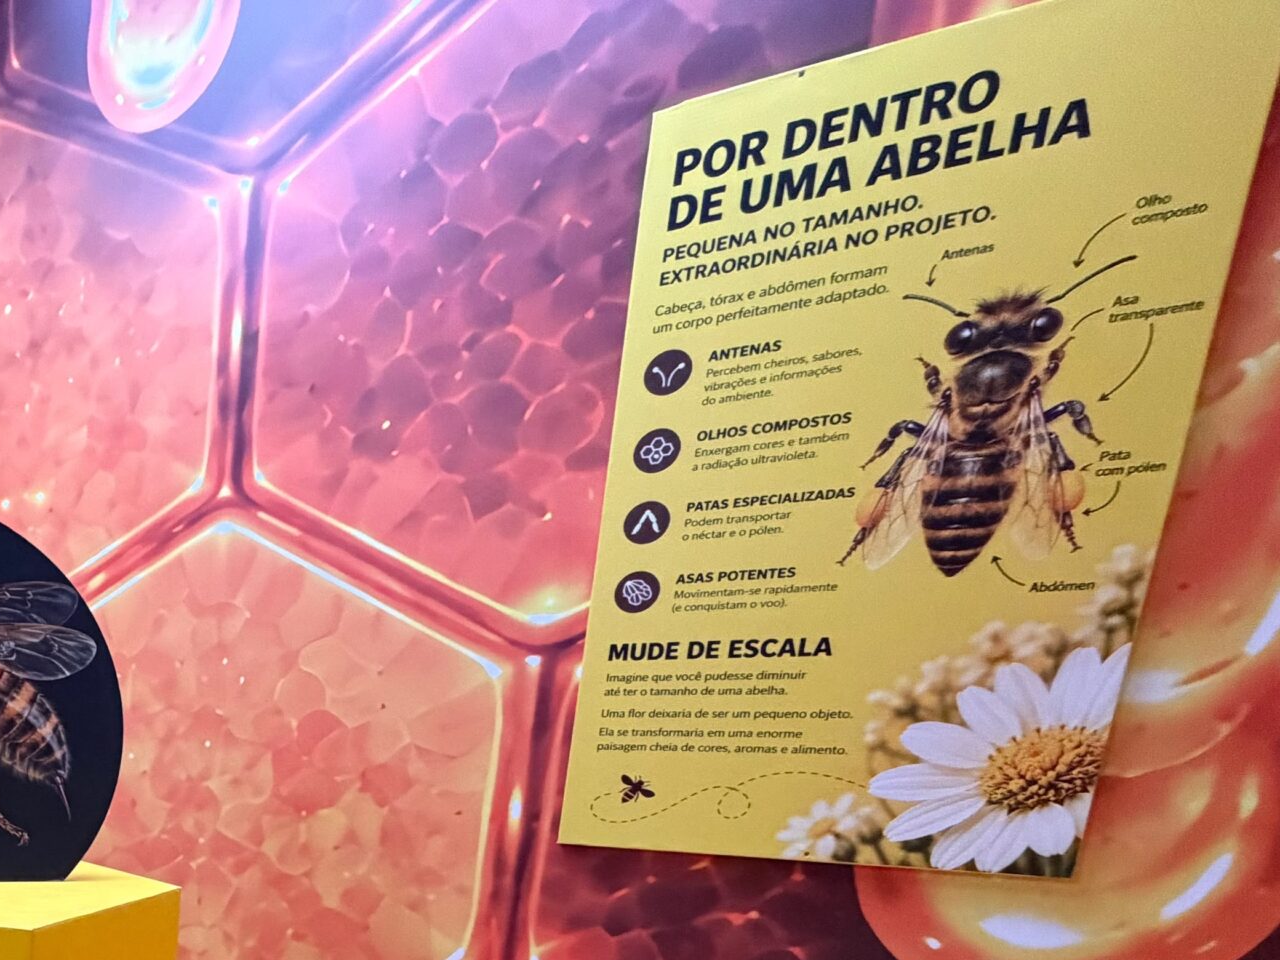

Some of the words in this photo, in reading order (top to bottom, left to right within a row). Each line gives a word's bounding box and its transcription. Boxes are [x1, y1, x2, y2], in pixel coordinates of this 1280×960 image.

[672, 130, 769, 187] POR
[781, 69, 1000, 160] DENTRO
[666, 184, 727, 232] DE
[739, 155, 851, 214] UMA
[865, 98, 1091, 187] ABELHA
[1135, 193, 1172, 209] Olho
[1131, 203, 1209, 226] composto
[662, 229, 757, 263] PEQUENA
[763, 221, 795, 242] NO
[801, 194, 923, 233] TAMANHO.
[659, 236, 838, 287] EXTRAORDINÁRIA
[844, 228, 879, 250] NO
[884, 205, 996, 241] PROJETO.
[940, 243, 995, 261] Antenas
[654, 300, 706, 317] Cabeça,
[709, 292, 744, 307] tórax
[746, 290, 756, 300] e
[758, 277, 826, 298] abdômen
[829, 265, 888, 285] formam
[652, 323, 673, 334] um
[674, 315, 713, 330] corpo
[715, 298, 812, 326] perfeitamente
[815, 282, 889, 306] adaptado.
[1111, 295, 1140, 308] Asa
[1108, 300, 1205, 323] transparente
[707, 339, 782, 362] ANTENAS
[705, 362, 761, 378] Percebem
[763, 356, 809, 370] cheiros,
[811, 347, 862, 363] sabores,
[703, 377, 757, 392] vibrações
[759, 375, 767, 384] e
[768, 364, 843, 383] informações
[701, 395, 716, 406] do
[718, 389, 774, 404] ambiente.
[696, 424, 748, 442] OLHOS
[751, 411, 852, 435] COMPOSTOS
[694, 444, 751, 458] Enxergam
[752, 440, 785, 451] cores
[786, 438, 796, 447] e
[798, 432, 850, 446] também
[691, 463, 699, 472] a
[700, 456, 749, 470] radiação
[750, 450, 818, 465] ultravioleta.
[1098, 450, 1132, 462] Pata
[1094, 466, 1125, 477] com
[1125, 461, 1167, 477] pólen
[686, 498, 729, 512] PATAS
[732, 486, 856, 508] ESPECIALIZADAS
[683, 516, 724, 528] Podem
[725, 511, 792, 524] transportar
[681, 533, 690, 541] o
[691, 529, 727, 540] néctar
[728, 530, 736, 538] e
[738, 529, 747, 537] o
[748, 525, 784, 538] pólen.
[675, 571, 714, 585] ASAS
[717, 566, 796, 582] POTENTES
[673, 587, 762, 599] Movimentam-se
[763, 583, 838, 596] rapidamente
[1028, 580, 1096, 593] Abdômen
[671, 602, 682, 614] (e
[683, 600, 748, 613] conquistam
[749, 601, 758, 609] o
[759, 597, 787, 608] voo).
[607, 641, 680, 661] MUDE
[686, 640, 721, 659] DE
[727, 636, 832, 659] ESCALA
[605, 673, 649, 685] Imagine
[650, 674, 673, 684] que
[674, 670, 702, 681] você
[703, 670, 754, 683] pudesse
[755, 669, 807, 680] diminuir
[603, 686, 621, 697] até
[622, 688, 639, 696] ter
[639, 688, 648, 696] o
[649, 686, 698, 696] tamanho
[699, 685, 715, 696] de
[717, 687, 743, 696] uma
[744, 685, 788, 696] abelha.
[600, 708, 625, 718] Uma
[627, 708, 646, 718] flor
[647, 708, 692, 718] deixaria
[694, 708, 709, 719] de
[711, 710, 730, 718] ser
[731, 710, 751, 719] um
[753, 710, 807, 721] pequeno
[809, 708, 853, 721] objeto.
[598, 727, 615, 737] Ela
[616, 729, 629, 737] se
[631, 727, 704, 738] transformaria
[706, 730, 726, 738] em
[727, 730, 754, 738] uma
[755, 730, 803, 739] enorme
[596, 743, 647, 753] paisagem
[648, 741, 678, 752] cheia
[680, 742, 695, 752] de
[697, 744, 731, 754] cores,
[733, 745, 778, 754] aromas
[780, 746, 789, 754] e
[790, 744, 848, 755] alimento.
